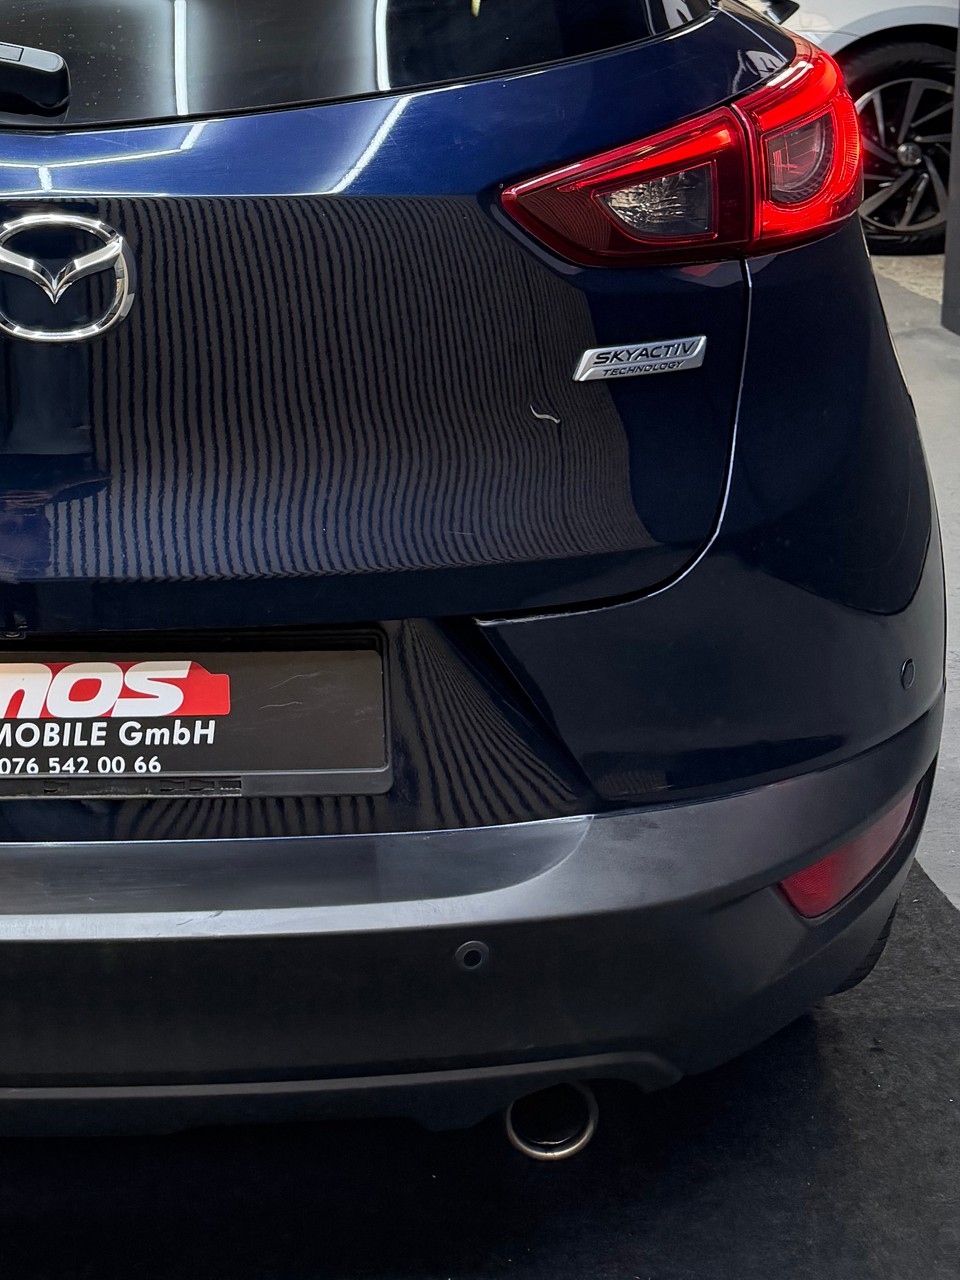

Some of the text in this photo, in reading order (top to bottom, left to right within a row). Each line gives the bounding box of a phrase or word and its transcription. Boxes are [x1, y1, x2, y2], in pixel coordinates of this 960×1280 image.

[593, 341, 695, 365] SKYACTIV
[603, 360, 684, 376] TECHNOLOGY
[119, 719, 216, 746] GmbH
[48, 757, 90, 774] 542
[97, 756, 126, 773] 00
[134, 756, 162, 773] 66
